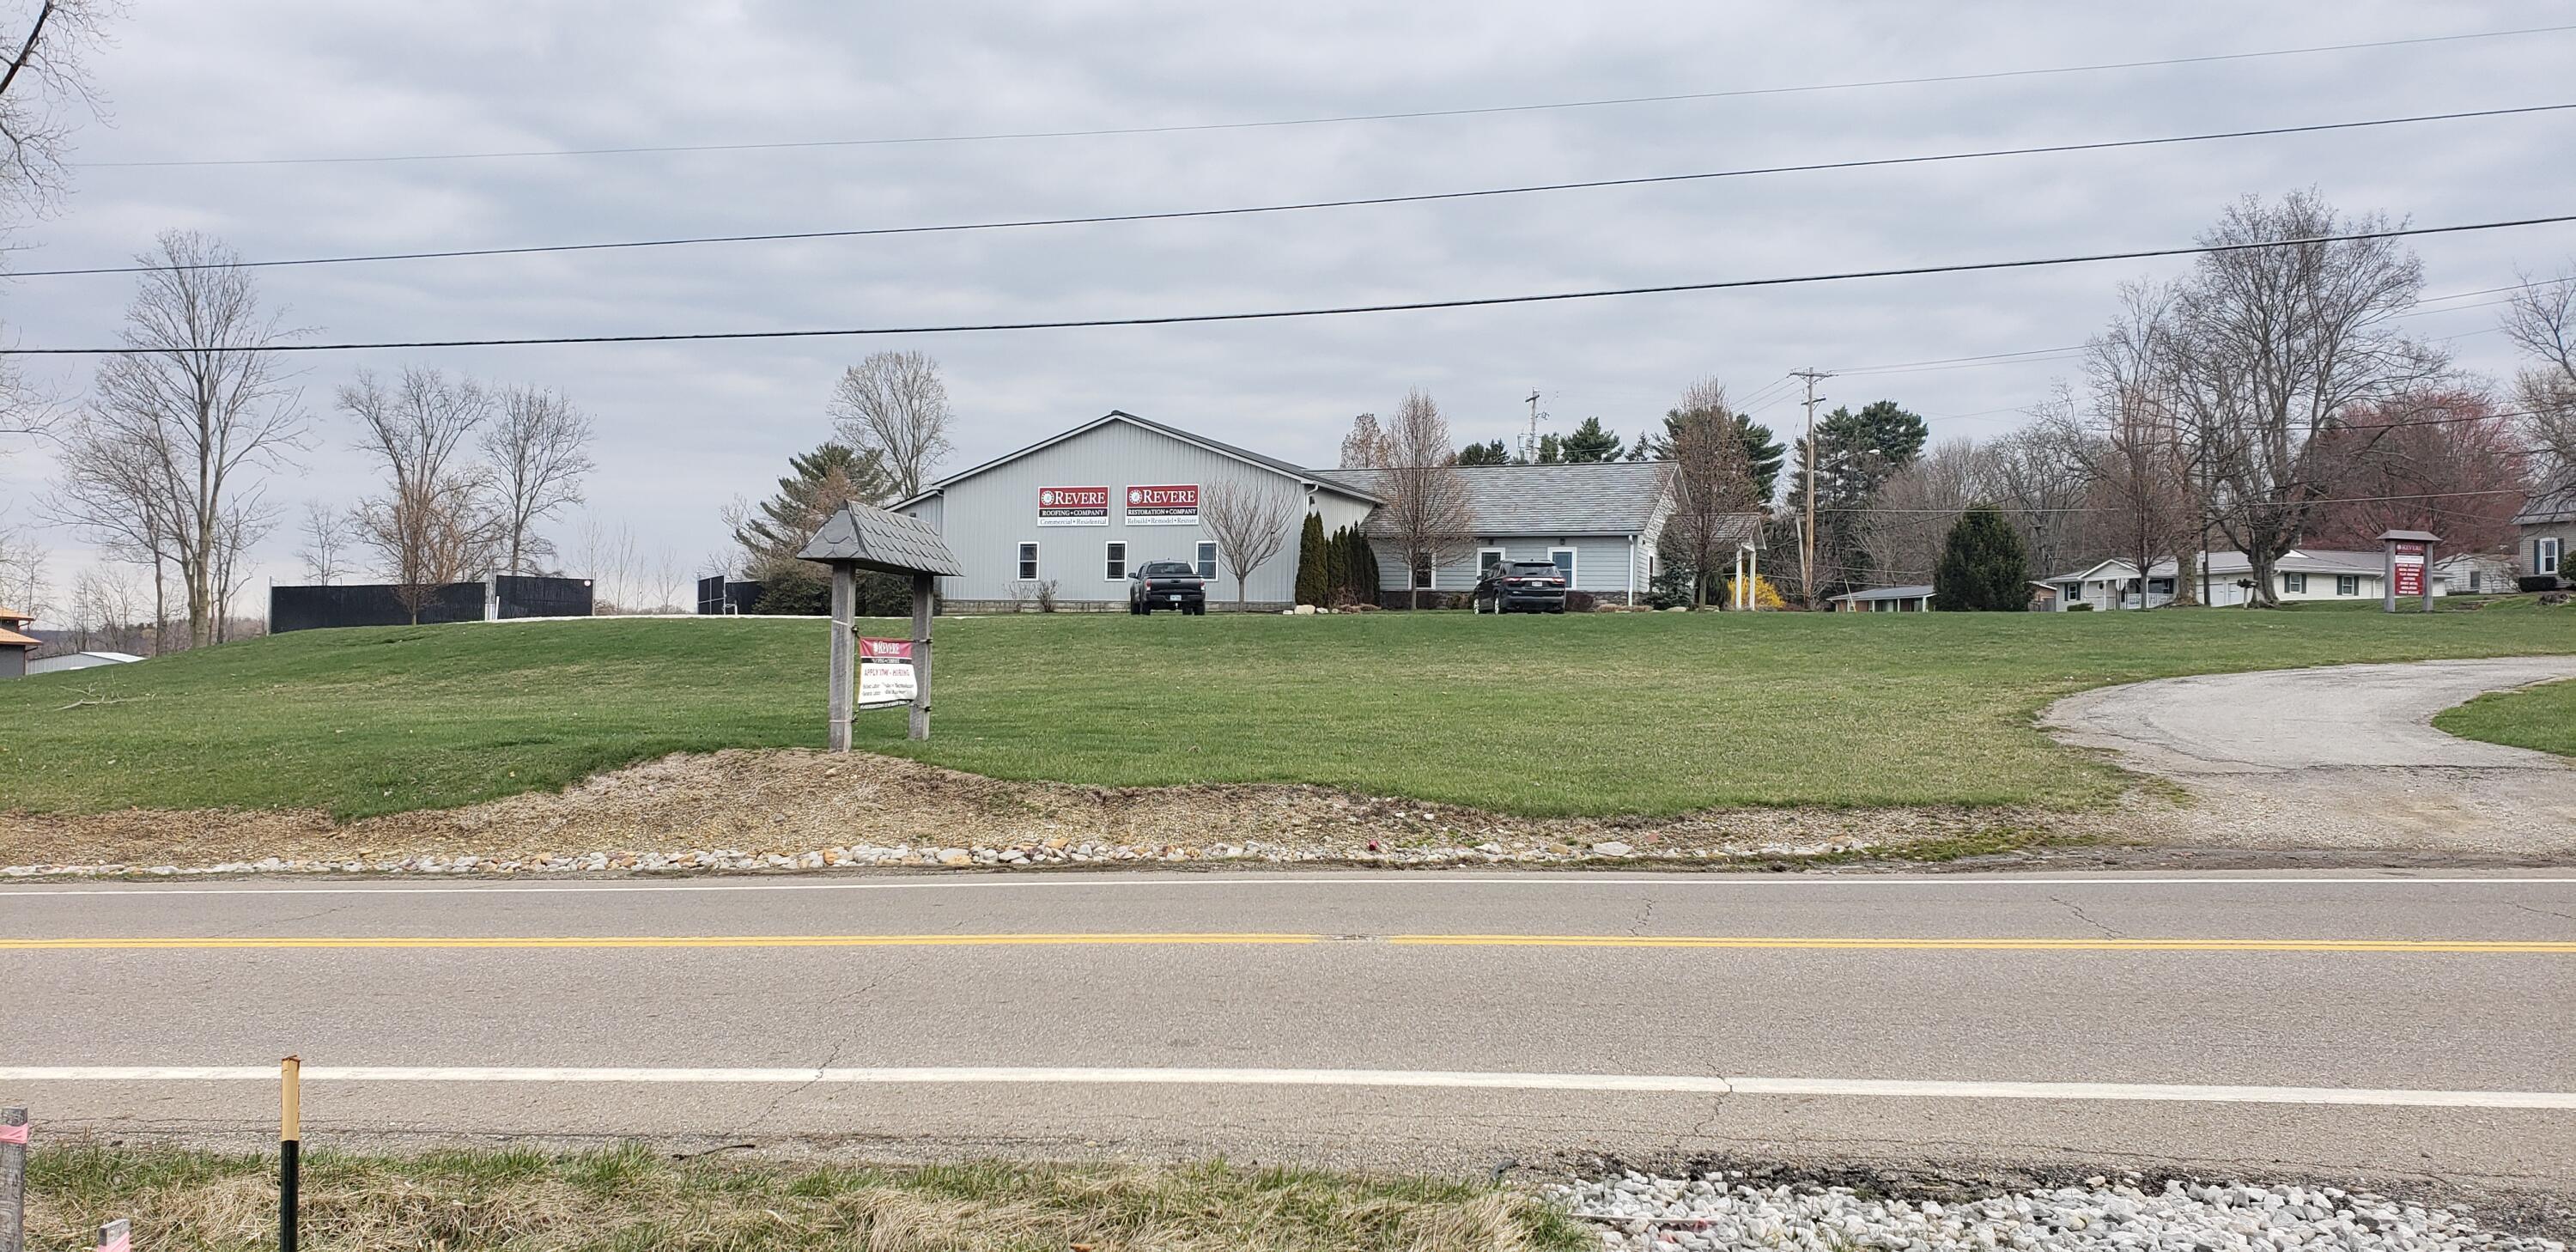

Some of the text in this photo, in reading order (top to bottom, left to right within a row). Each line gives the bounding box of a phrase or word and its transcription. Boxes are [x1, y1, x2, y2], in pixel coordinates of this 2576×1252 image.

[1054, 490, 1105, 504] REVERE
[1142, 489, 1195, 503] REVERE
[878, 641, 900, 654] REVERE
